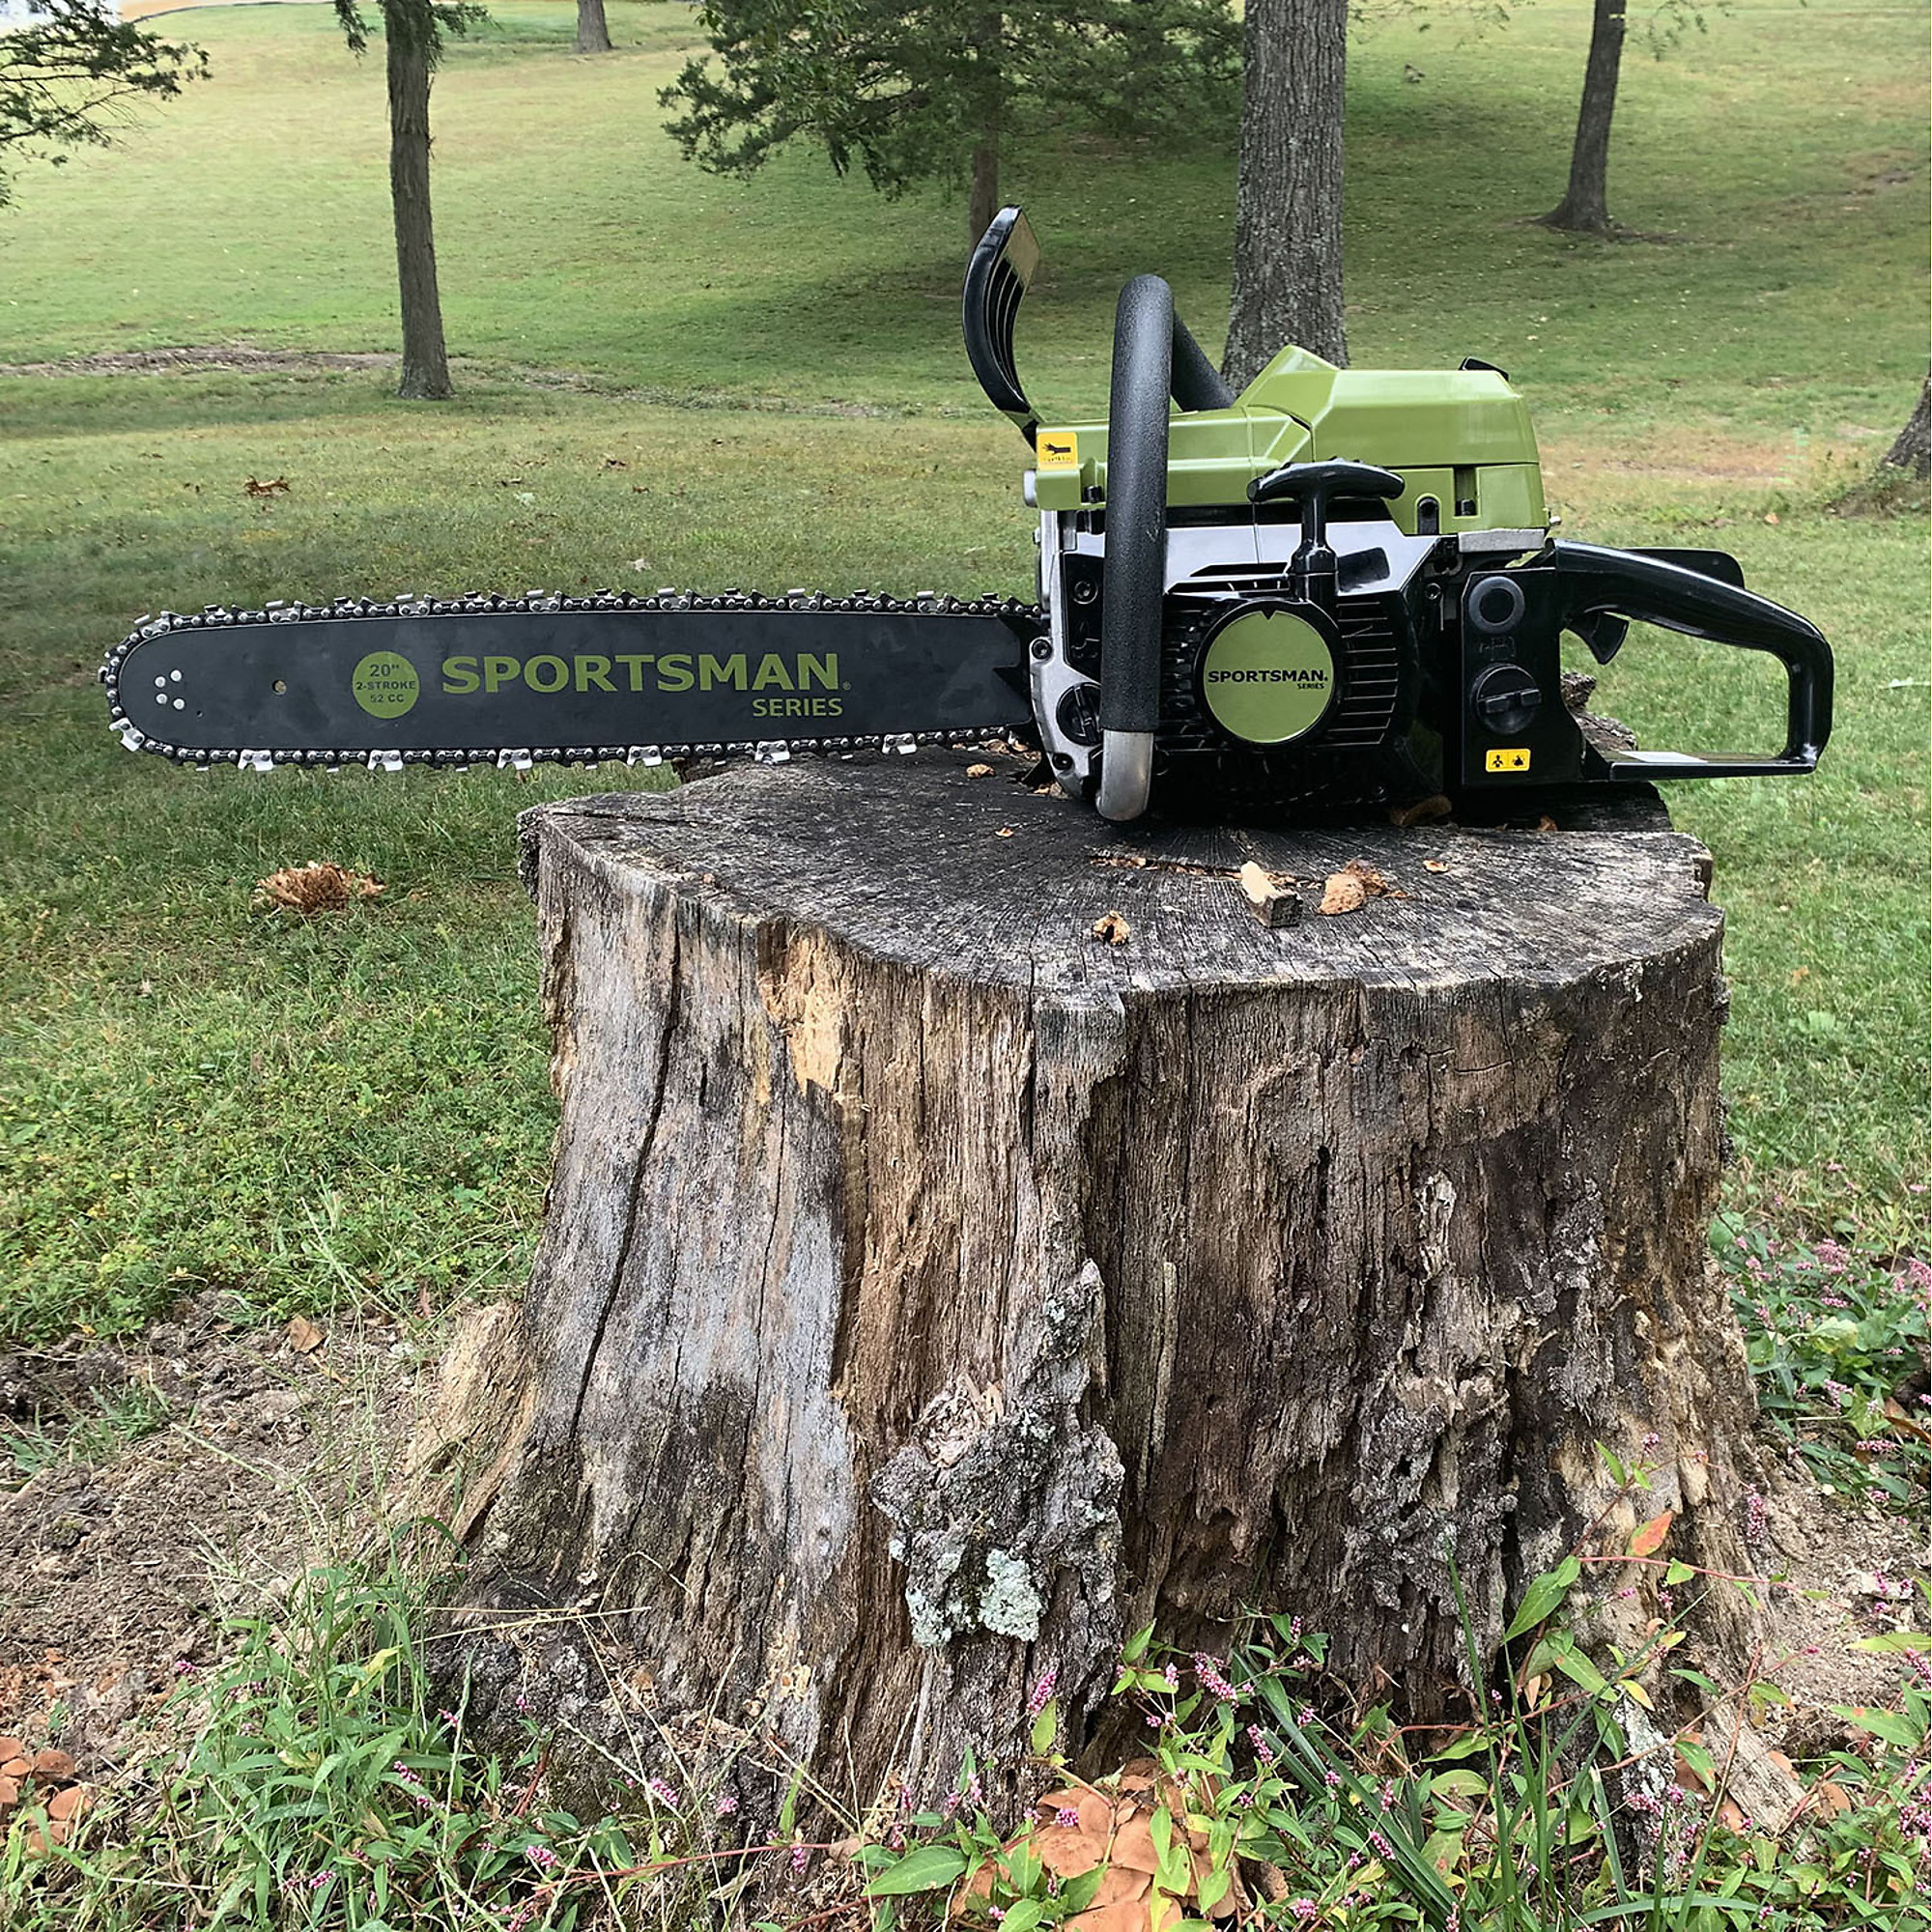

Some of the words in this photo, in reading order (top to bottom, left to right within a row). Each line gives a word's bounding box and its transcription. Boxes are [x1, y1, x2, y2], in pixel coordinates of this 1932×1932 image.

[355, 680, 416, 691] 2-STROKE
[370, 694, 384, 703] 52
[387, 694, 404, 703] CC
[752, 697, 843, 717] SERIES
